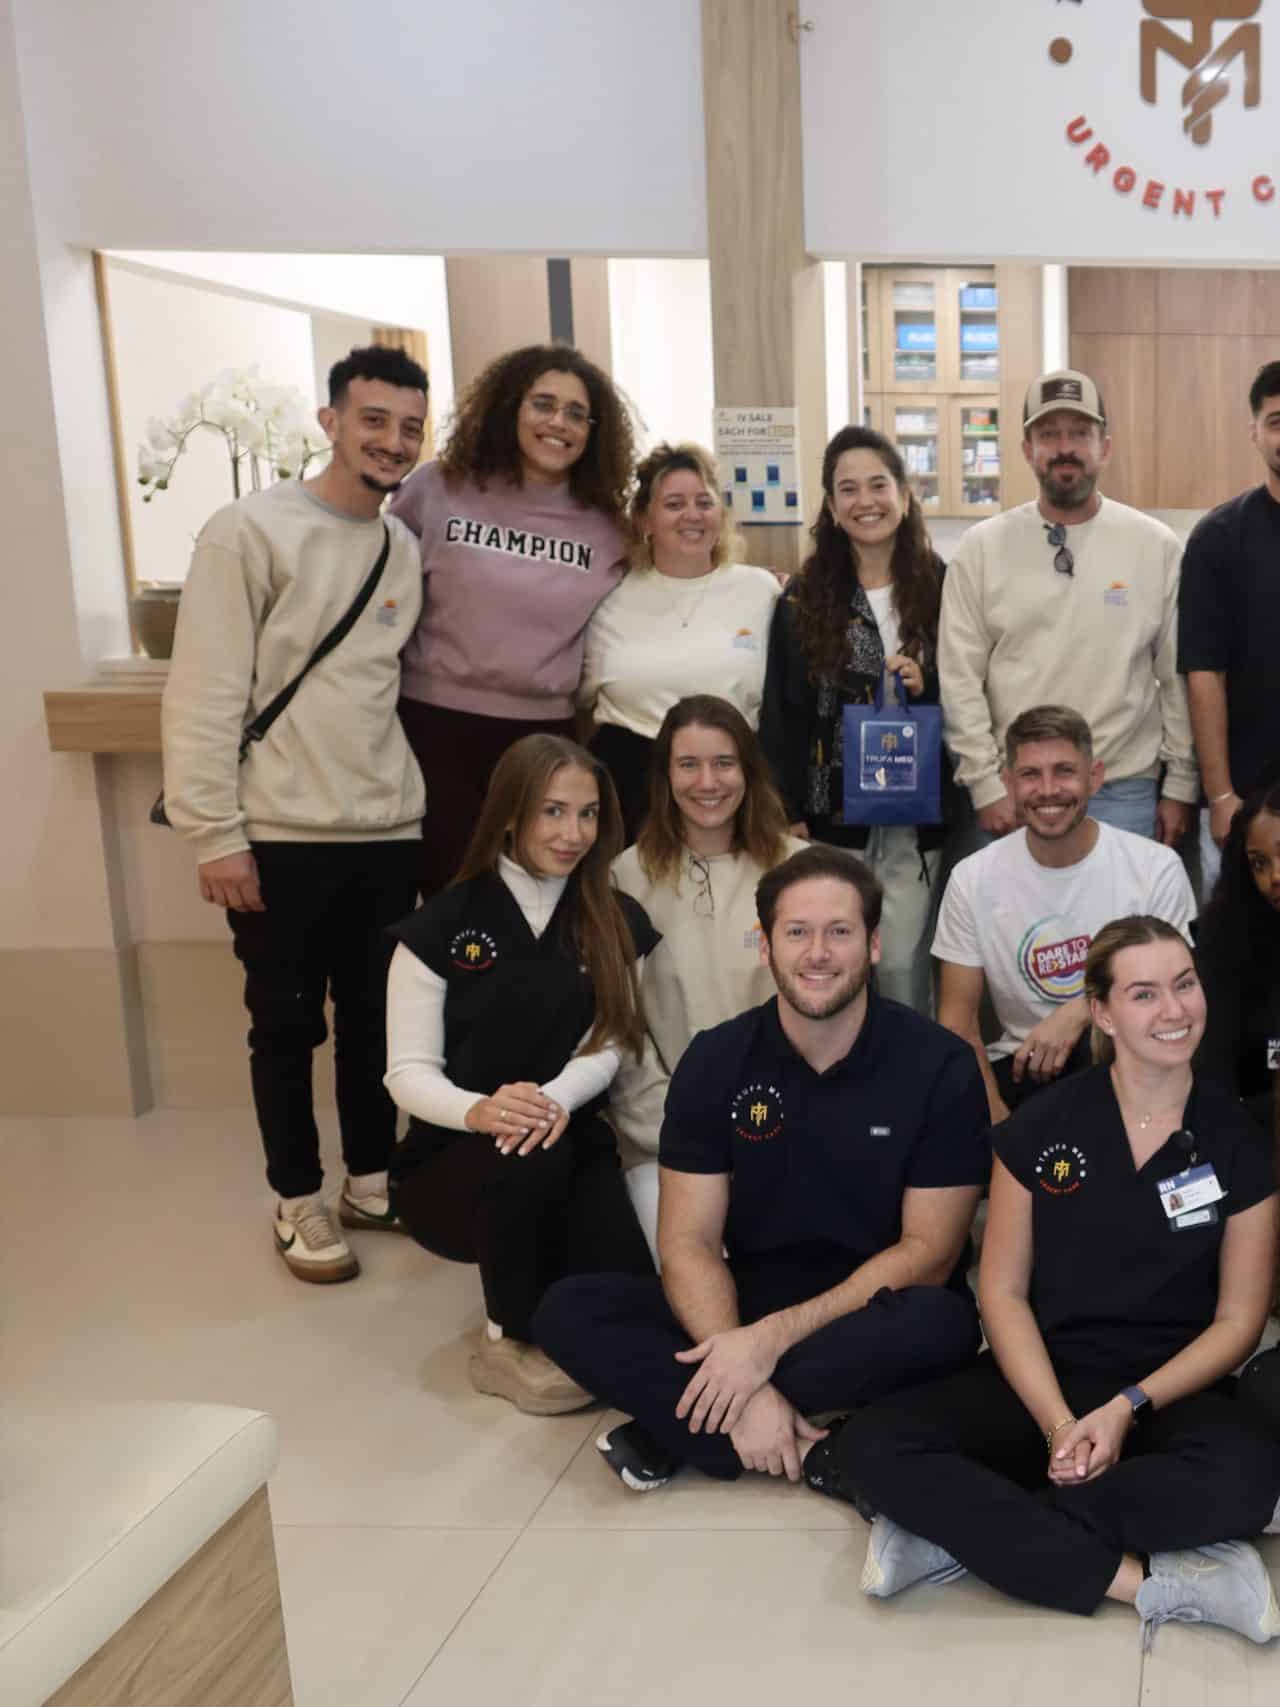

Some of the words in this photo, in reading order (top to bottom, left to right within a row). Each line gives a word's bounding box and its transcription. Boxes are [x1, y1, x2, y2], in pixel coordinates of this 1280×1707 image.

[1066, 115, 1225, 217] URGENT
[445, 517, 593, 573] CHAMPION
[1037, 943, 1070, 961] DARE
[1070, 938, 1088, 952] TO
